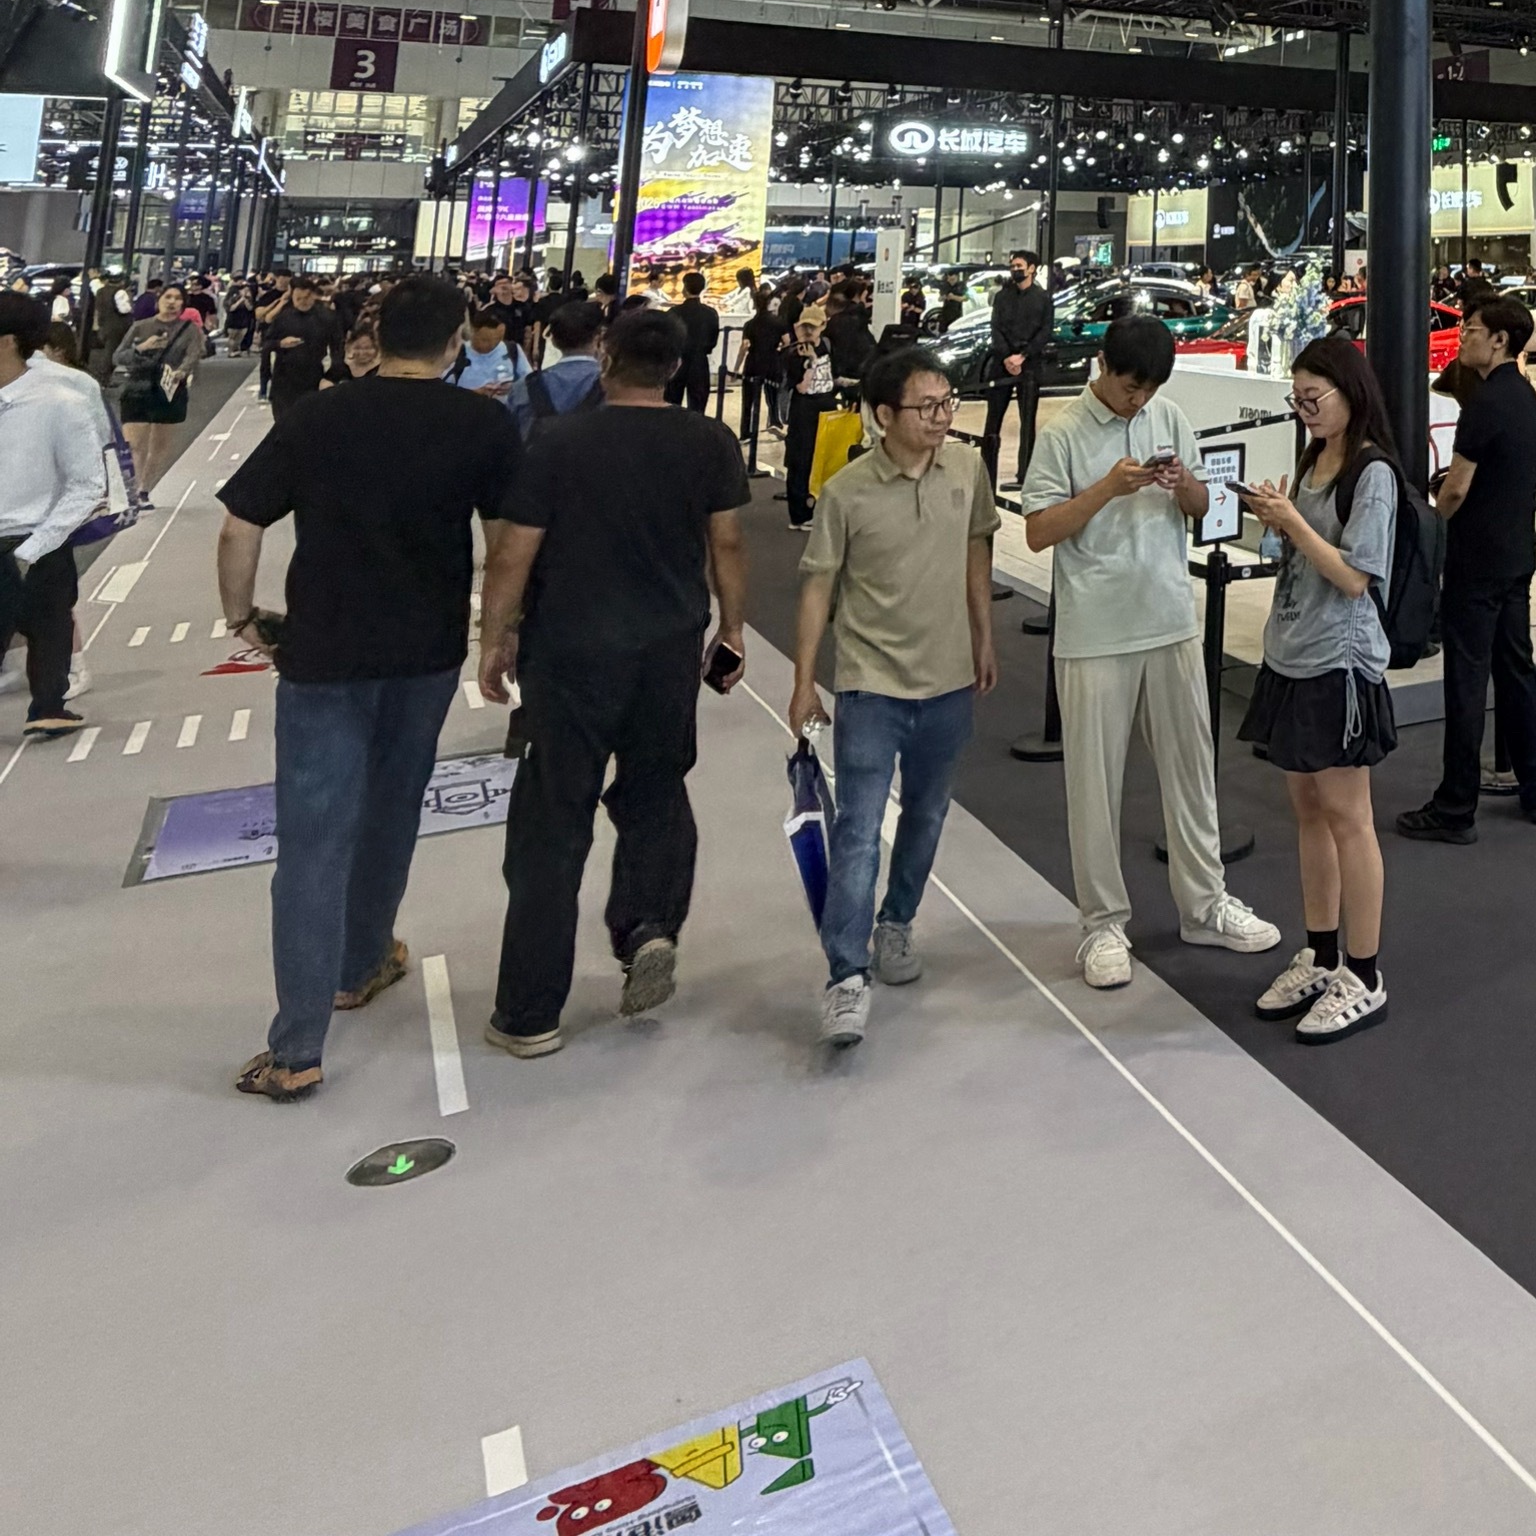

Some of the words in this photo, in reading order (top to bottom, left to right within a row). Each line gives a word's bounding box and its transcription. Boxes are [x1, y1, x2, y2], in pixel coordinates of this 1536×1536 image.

[279, 7, 458, 37] 三楼美食广场
[353, 49, 376, 79] 3
